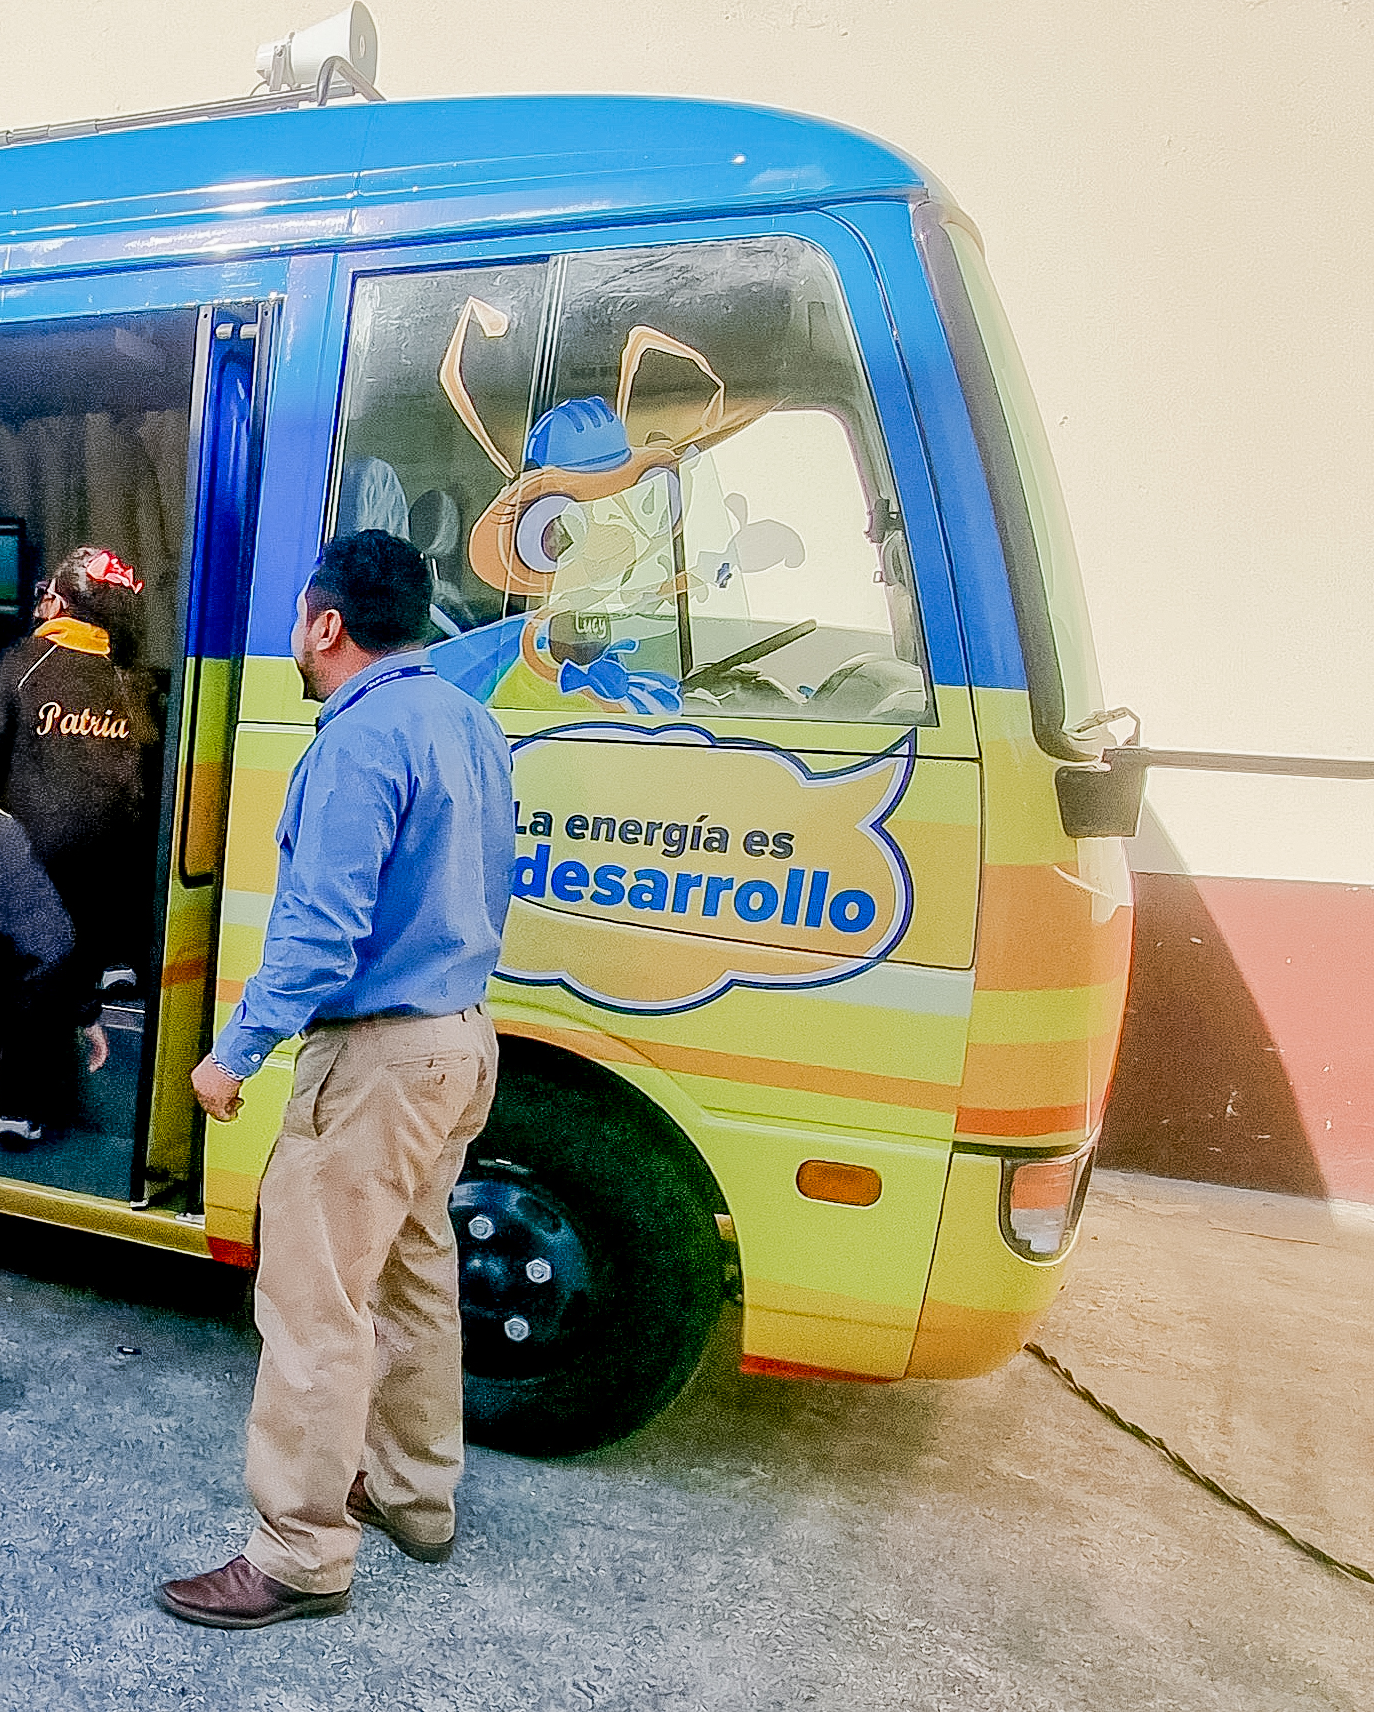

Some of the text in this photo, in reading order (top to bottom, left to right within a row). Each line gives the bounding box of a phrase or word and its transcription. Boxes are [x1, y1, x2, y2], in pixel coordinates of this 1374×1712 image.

[36, 701, 129, 739] Patria
[513, 800, 795, 859] La energía es
[511, 844, 877, 933] desarrollo
